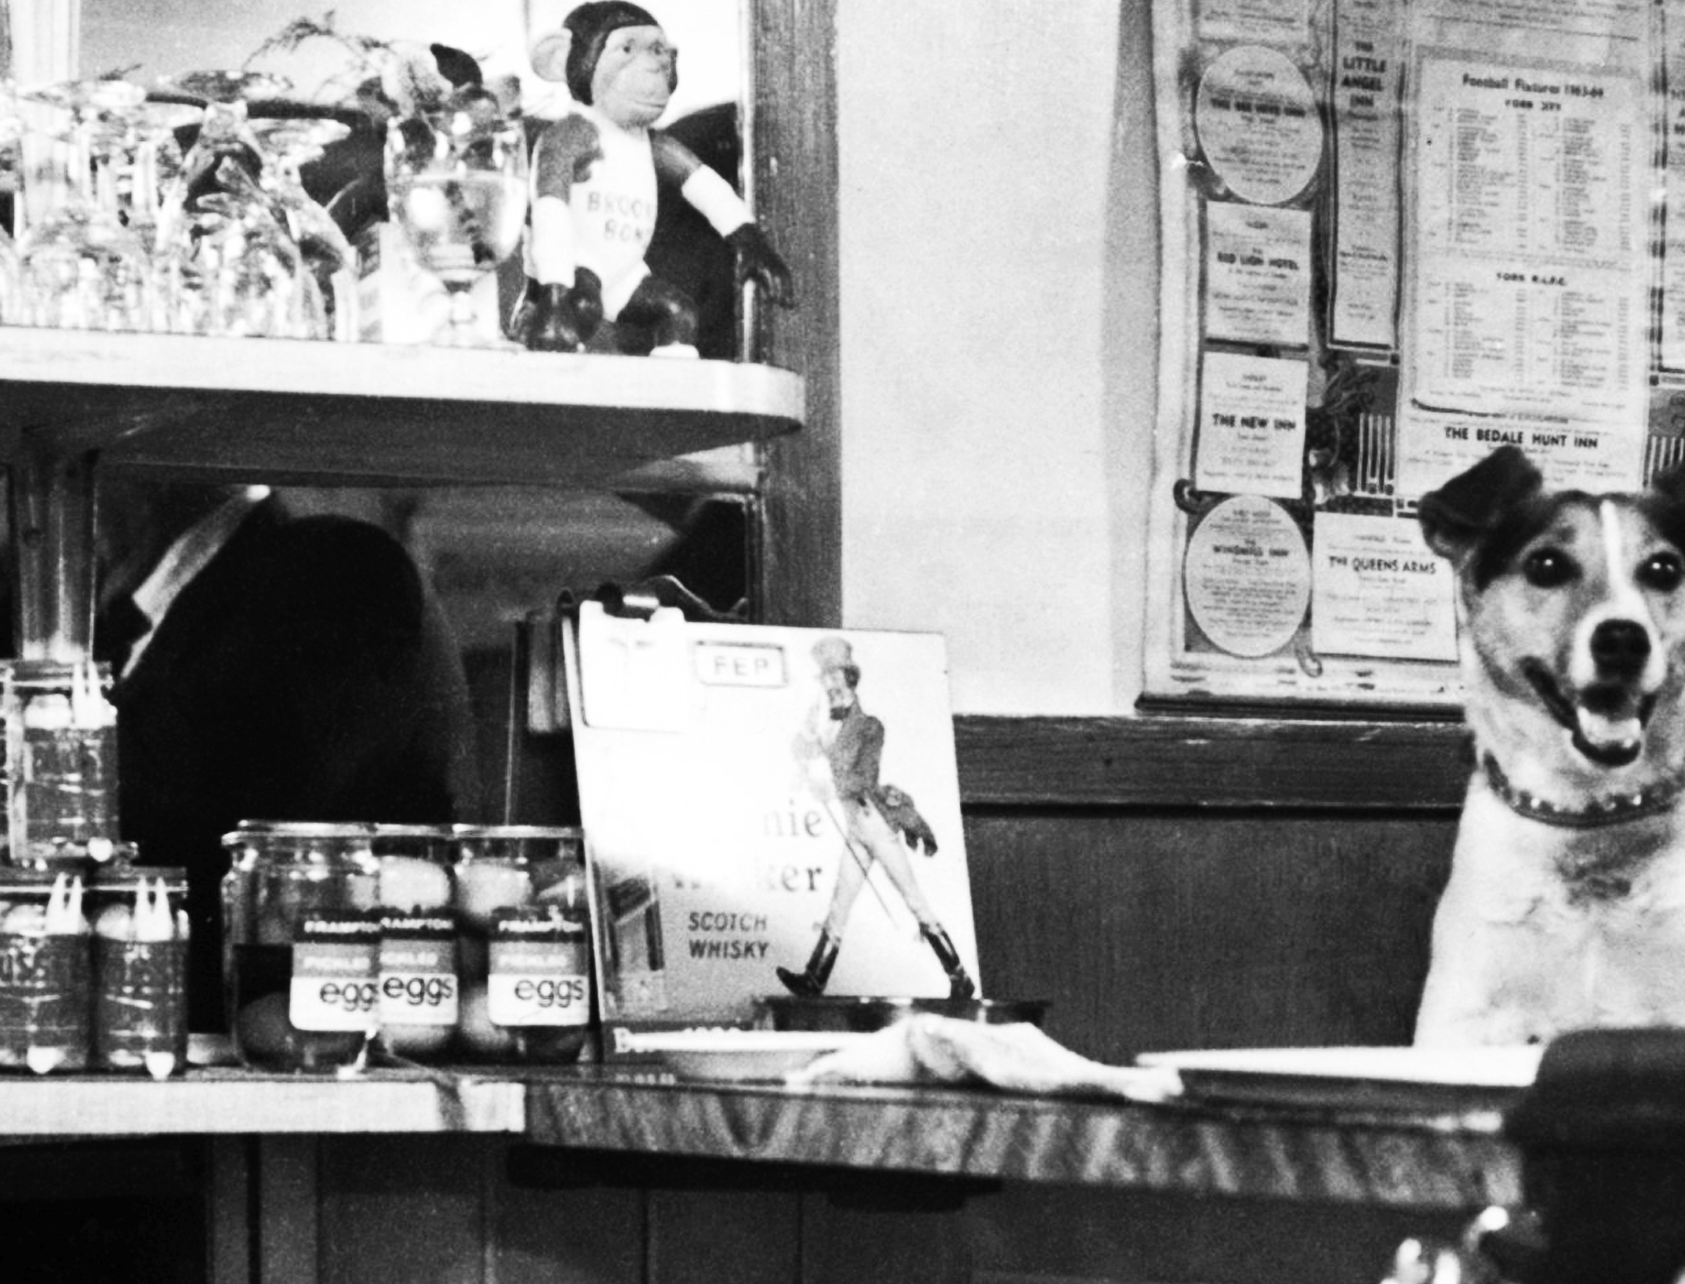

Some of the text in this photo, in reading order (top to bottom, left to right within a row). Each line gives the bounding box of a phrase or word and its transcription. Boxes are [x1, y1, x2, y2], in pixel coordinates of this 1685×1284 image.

[1342, 56, 1387, 74] LITTLE
[1340, 75, 1384, 93] ANGEL
[1349, 93, 1375, 108] INN
[1267, 255, 1301, 274] HOTEL
[1210, 411, 1299, 433] THE NEW INN
[1442, 425, 1598, 449] THE BEDALE HUNT INN
[1327, 554, 1438, 577] THE QUEENS ARMS
[687, 910, 768, 933] SCOTCH
[688, 938, 770, 961] WHISKY
[382, 974, 454, 1007] eggs
[514, 977, 585, 1008] eggs
